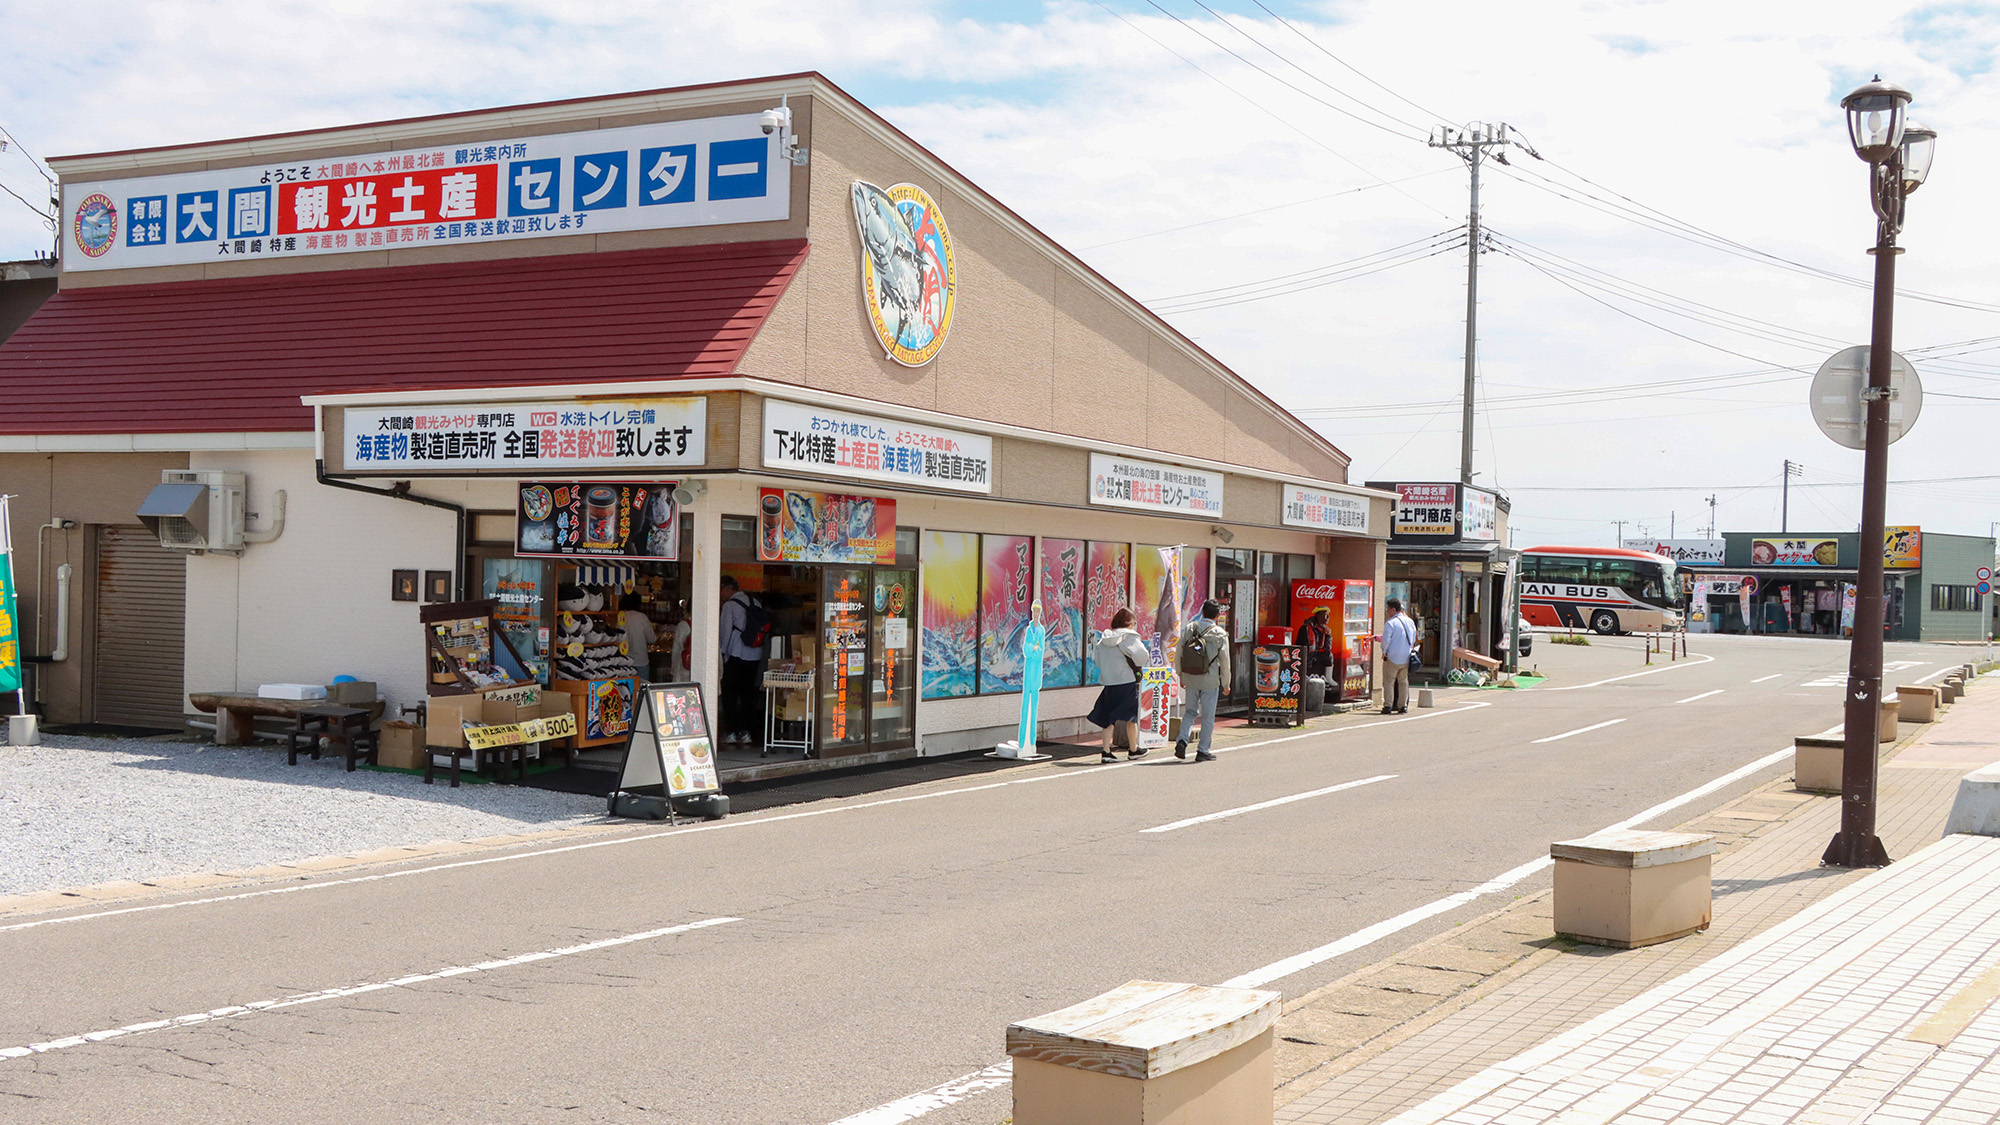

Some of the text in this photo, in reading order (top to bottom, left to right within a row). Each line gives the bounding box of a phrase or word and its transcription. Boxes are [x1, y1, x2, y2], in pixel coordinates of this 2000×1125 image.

[260, 143, 527, 184] ようこそ 大間崎へ本州最北端 観光案内所
[132, 199, 162, 221] 有限
[181, 151, 759, 240] 大間観光土産センター
[132, 223, 162, 243] 会社
[218, 239, 263, 255] 大間崎
[270, 237, 297, 252] 特産
[306, 233, 349, 250] 海産物
[866, 276, 948, 363] OMA KANKO MIYAGE CENTER
[378, 409, 656, 431] 大間崎観光みやげ専門店 WC 水洗トイレ完備
[811, 416, 960, 452] おつかれ様でした。 ようこそ大間崎へ
[355, 425, 693, 461] 海産物 製造直売所 全国発送歓迎致します
[882, 444, 922, 475] 海産物
[925, 451, 987, 485] 製造直売所
[1115, 478, 1190, 507] 大間観光土産センター
[1404, 487, 1447, 496] 大間崎名産
[569, 485, 581, 545] まぐろの
[826, 497, 839, 543] 大間
[1399, 508, 1452, 523] 土門商店
[1777, 552, 1813, 563] マグロ
[1784, 541, 1806, 549] 大間
[1016, 544, 1030, 602] マグロ
[1061, 547, 1076, 599] 一番
[1103, 564, 1117, 619] 大間
[1566, 586, 1608, 598] BUS
[1291, 649, 1302, 695] まぐろの
